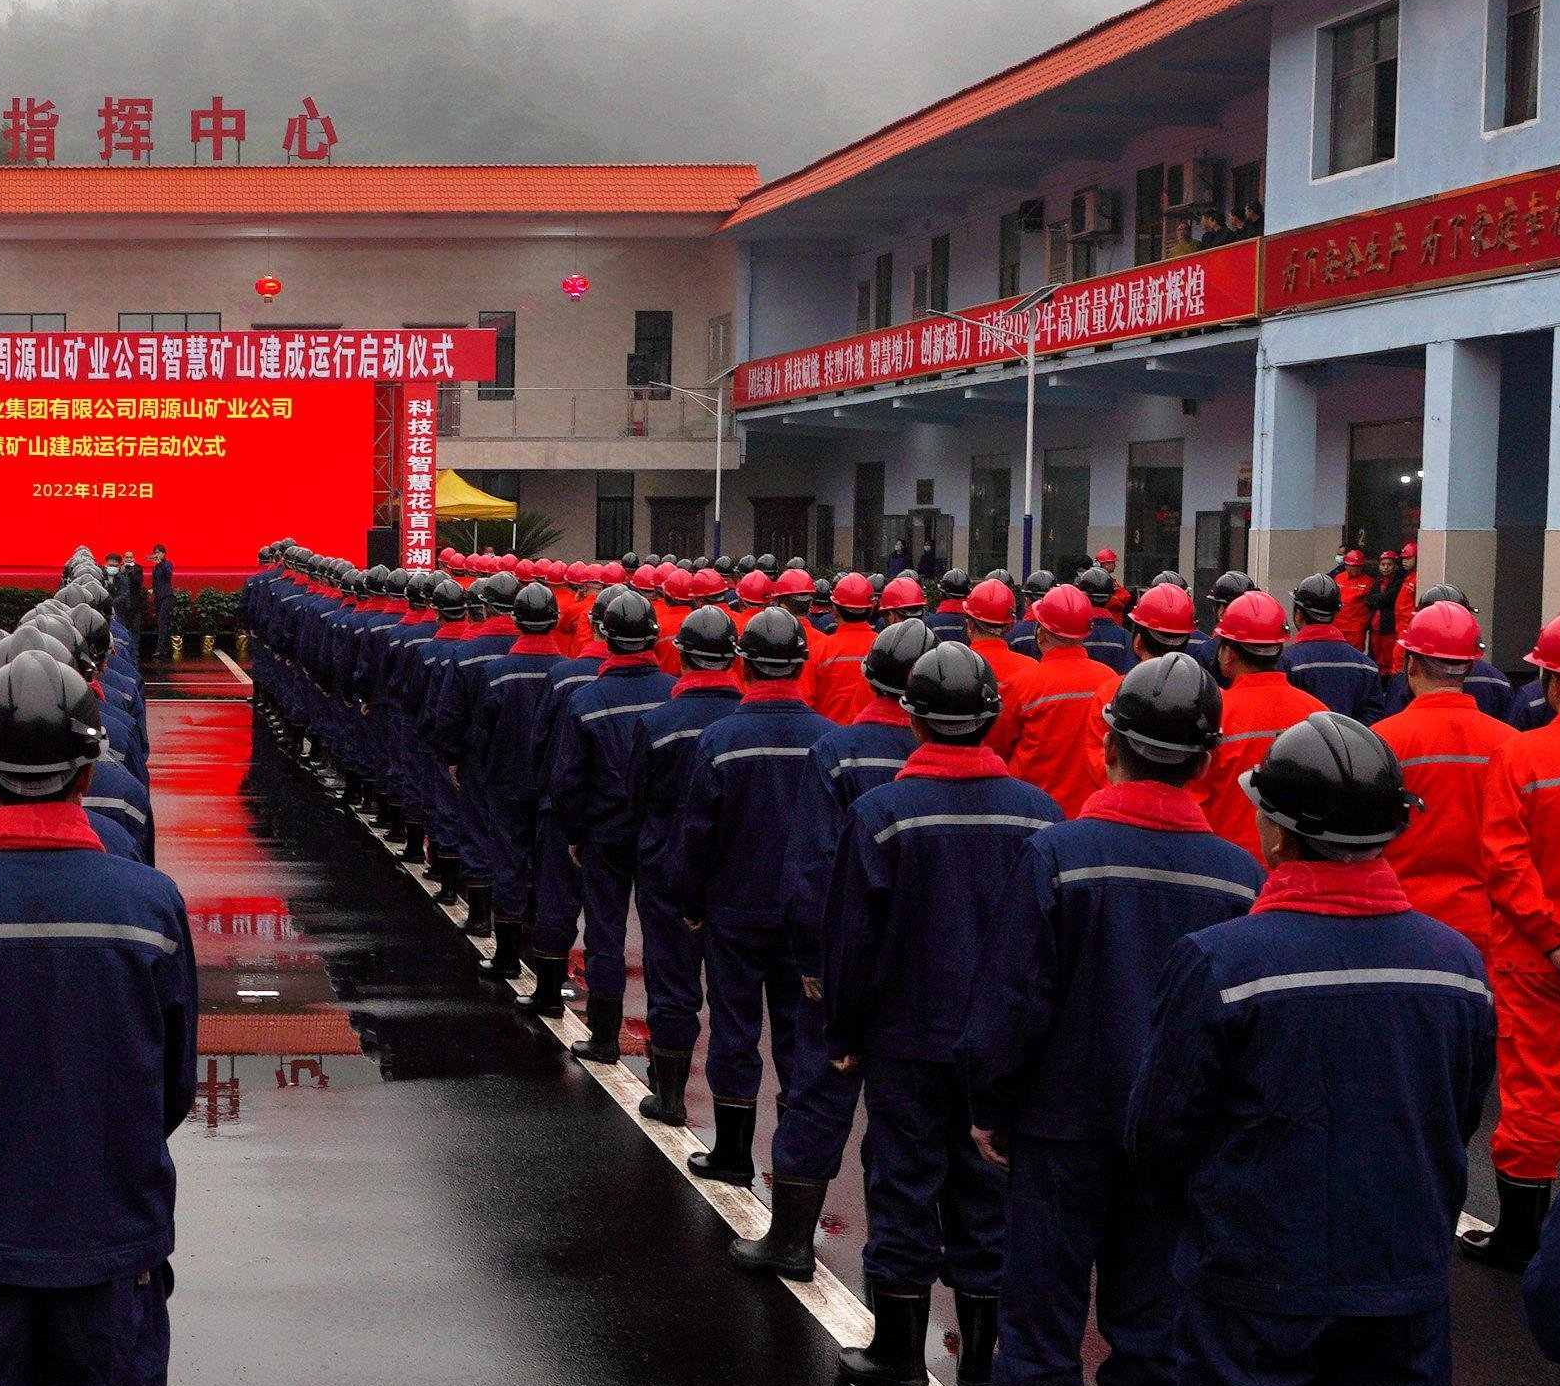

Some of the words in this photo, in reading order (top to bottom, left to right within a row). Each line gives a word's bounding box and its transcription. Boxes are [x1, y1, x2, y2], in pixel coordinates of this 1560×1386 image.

[823, 344, 865, 387] 转型升级
[869, 330, 914, 377] 智慧增力
[977, 264, 1206, 358] 再铸2022年高质量发展新辉煌
[33, 483, 154, 499] 2022年1月22日
